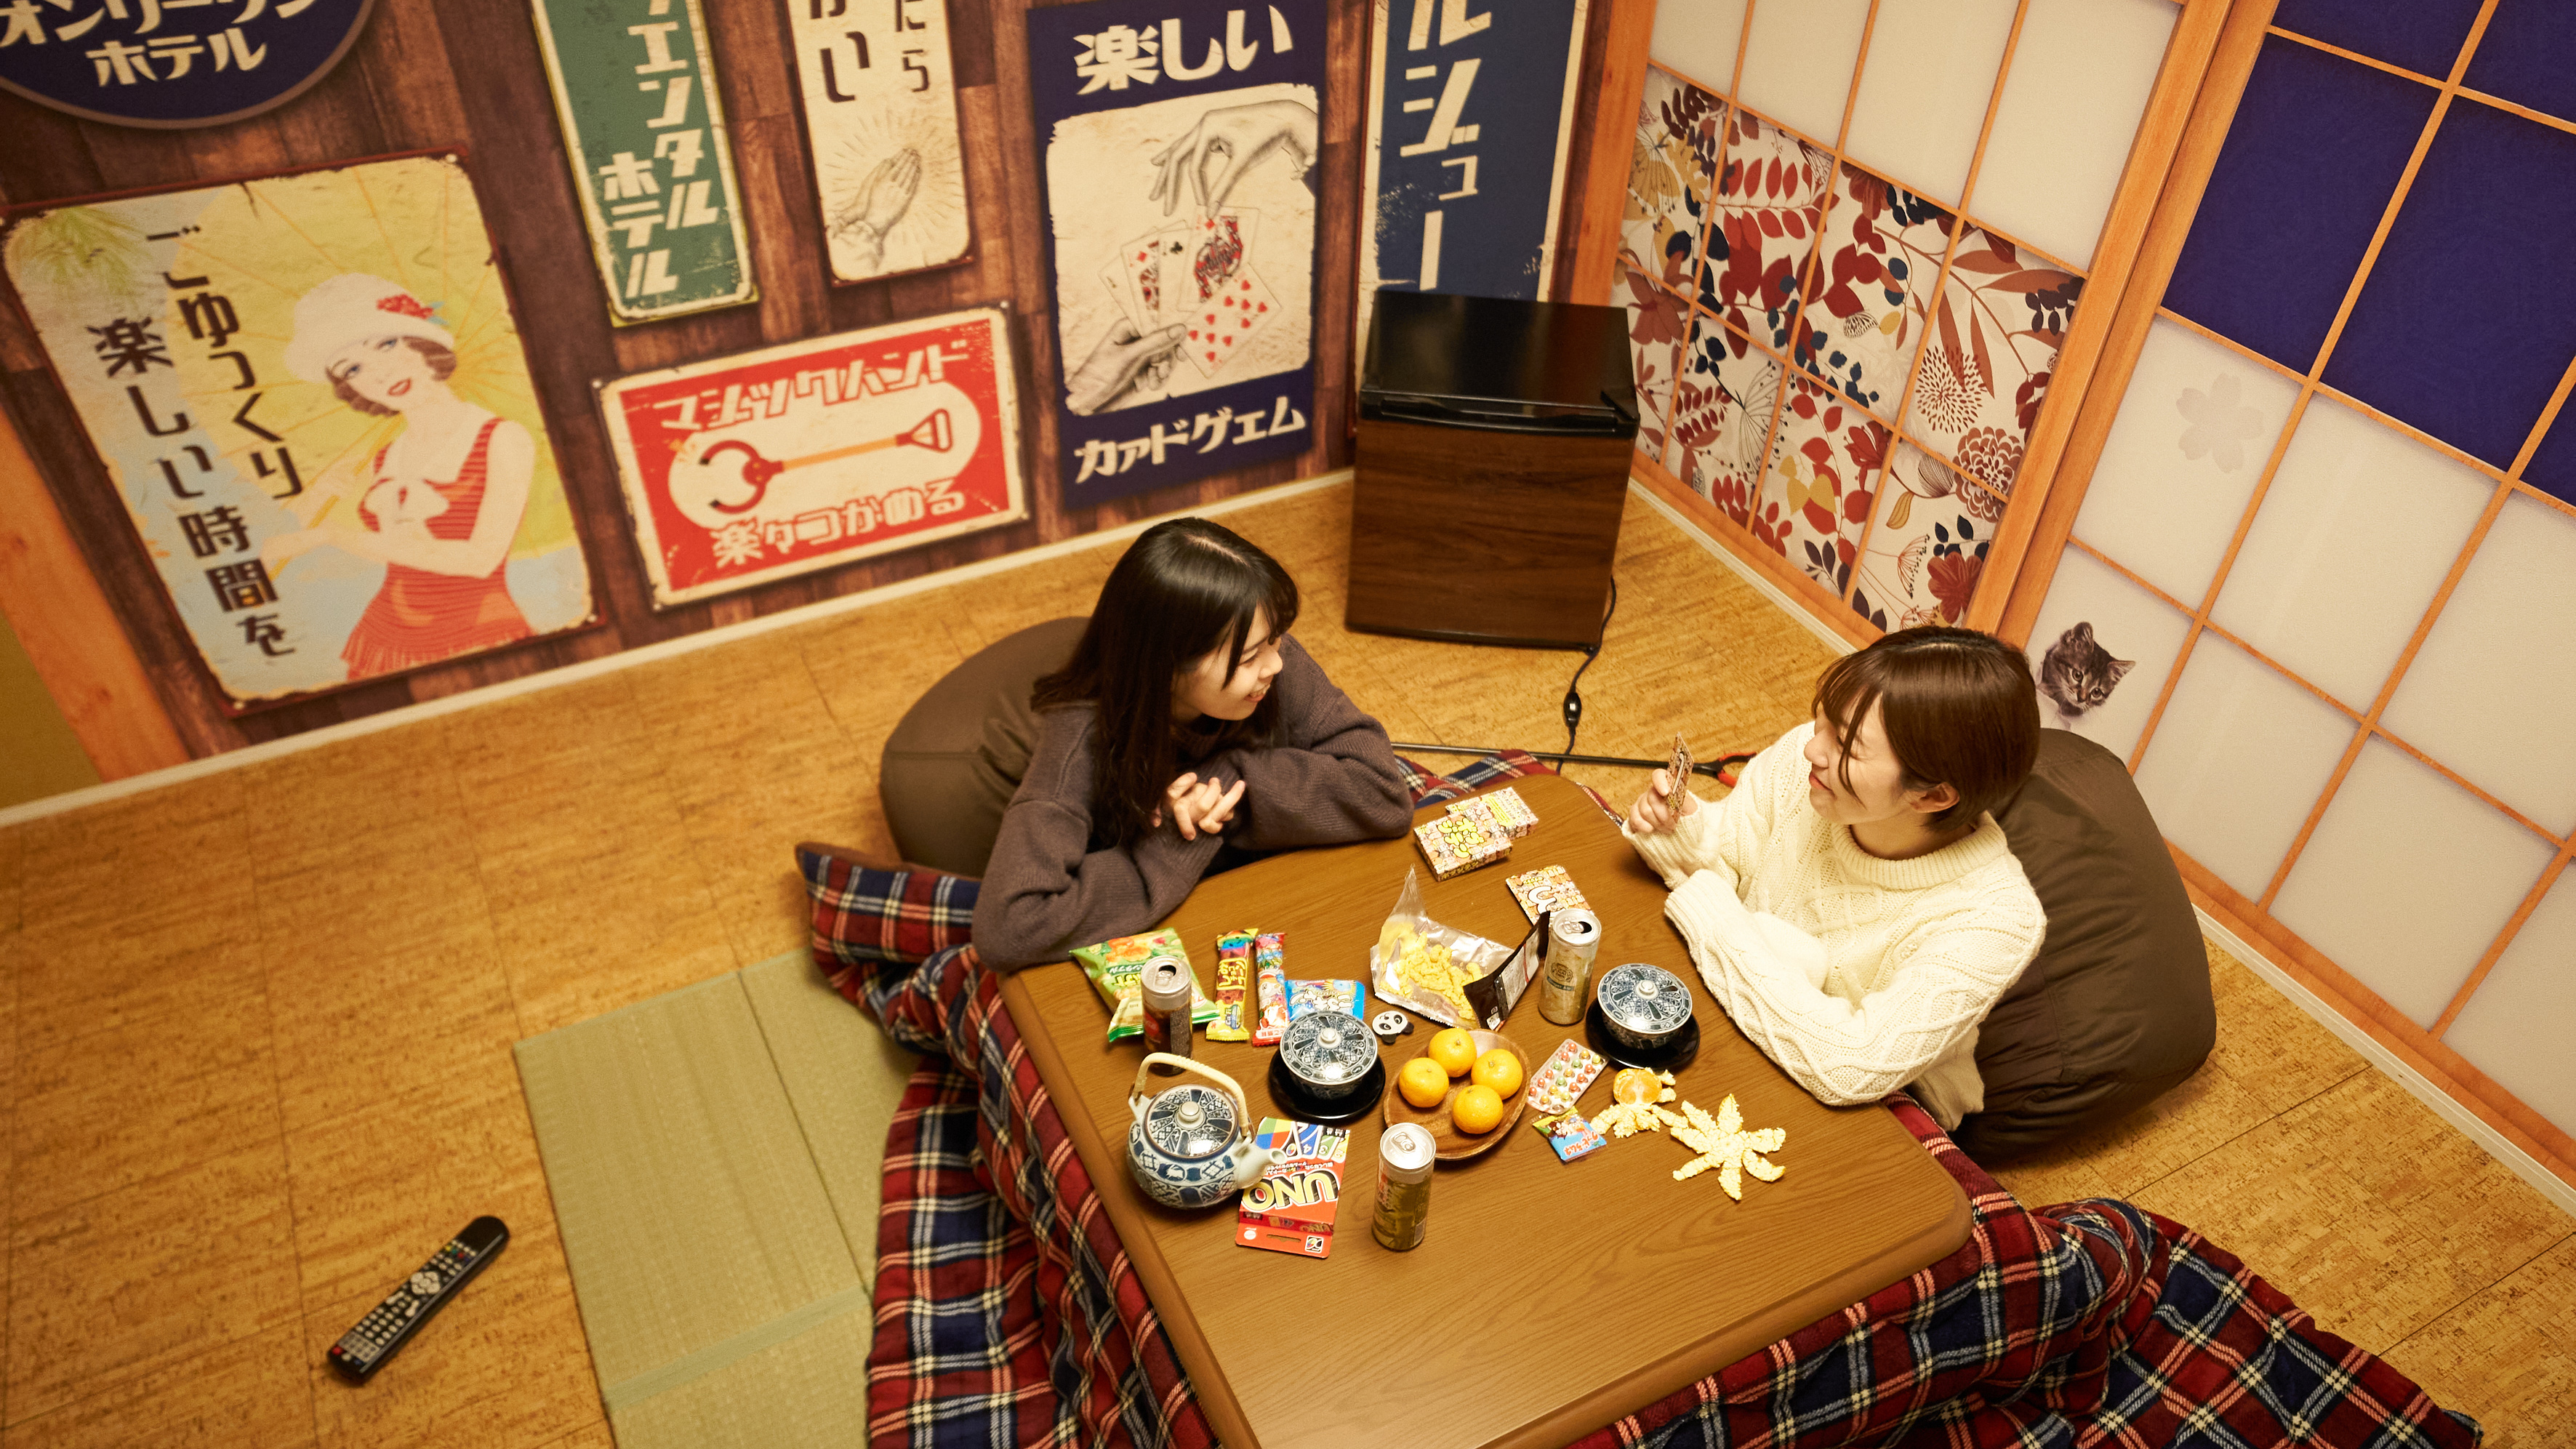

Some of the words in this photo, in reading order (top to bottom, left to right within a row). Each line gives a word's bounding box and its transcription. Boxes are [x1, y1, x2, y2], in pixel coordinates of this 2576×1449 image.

[85, 26, 267, 87] ホテル
[1073, 4, 1294, 96] 楽しい
[627, 0, 719, 230] エンタル
[598, 150, 679, 298] ホテル
[146, 224, 303, 500] ごゆっくり
[652, 338, 970, 432] マジックハンド
[85, 315, 296, 657] 楽しい時間を
[1074, 396, 1307, 485] カァドゲェム
[709, 476, 966, 569] 楽々つかめる
[1242, 1170, 1339, 1211] UNO
